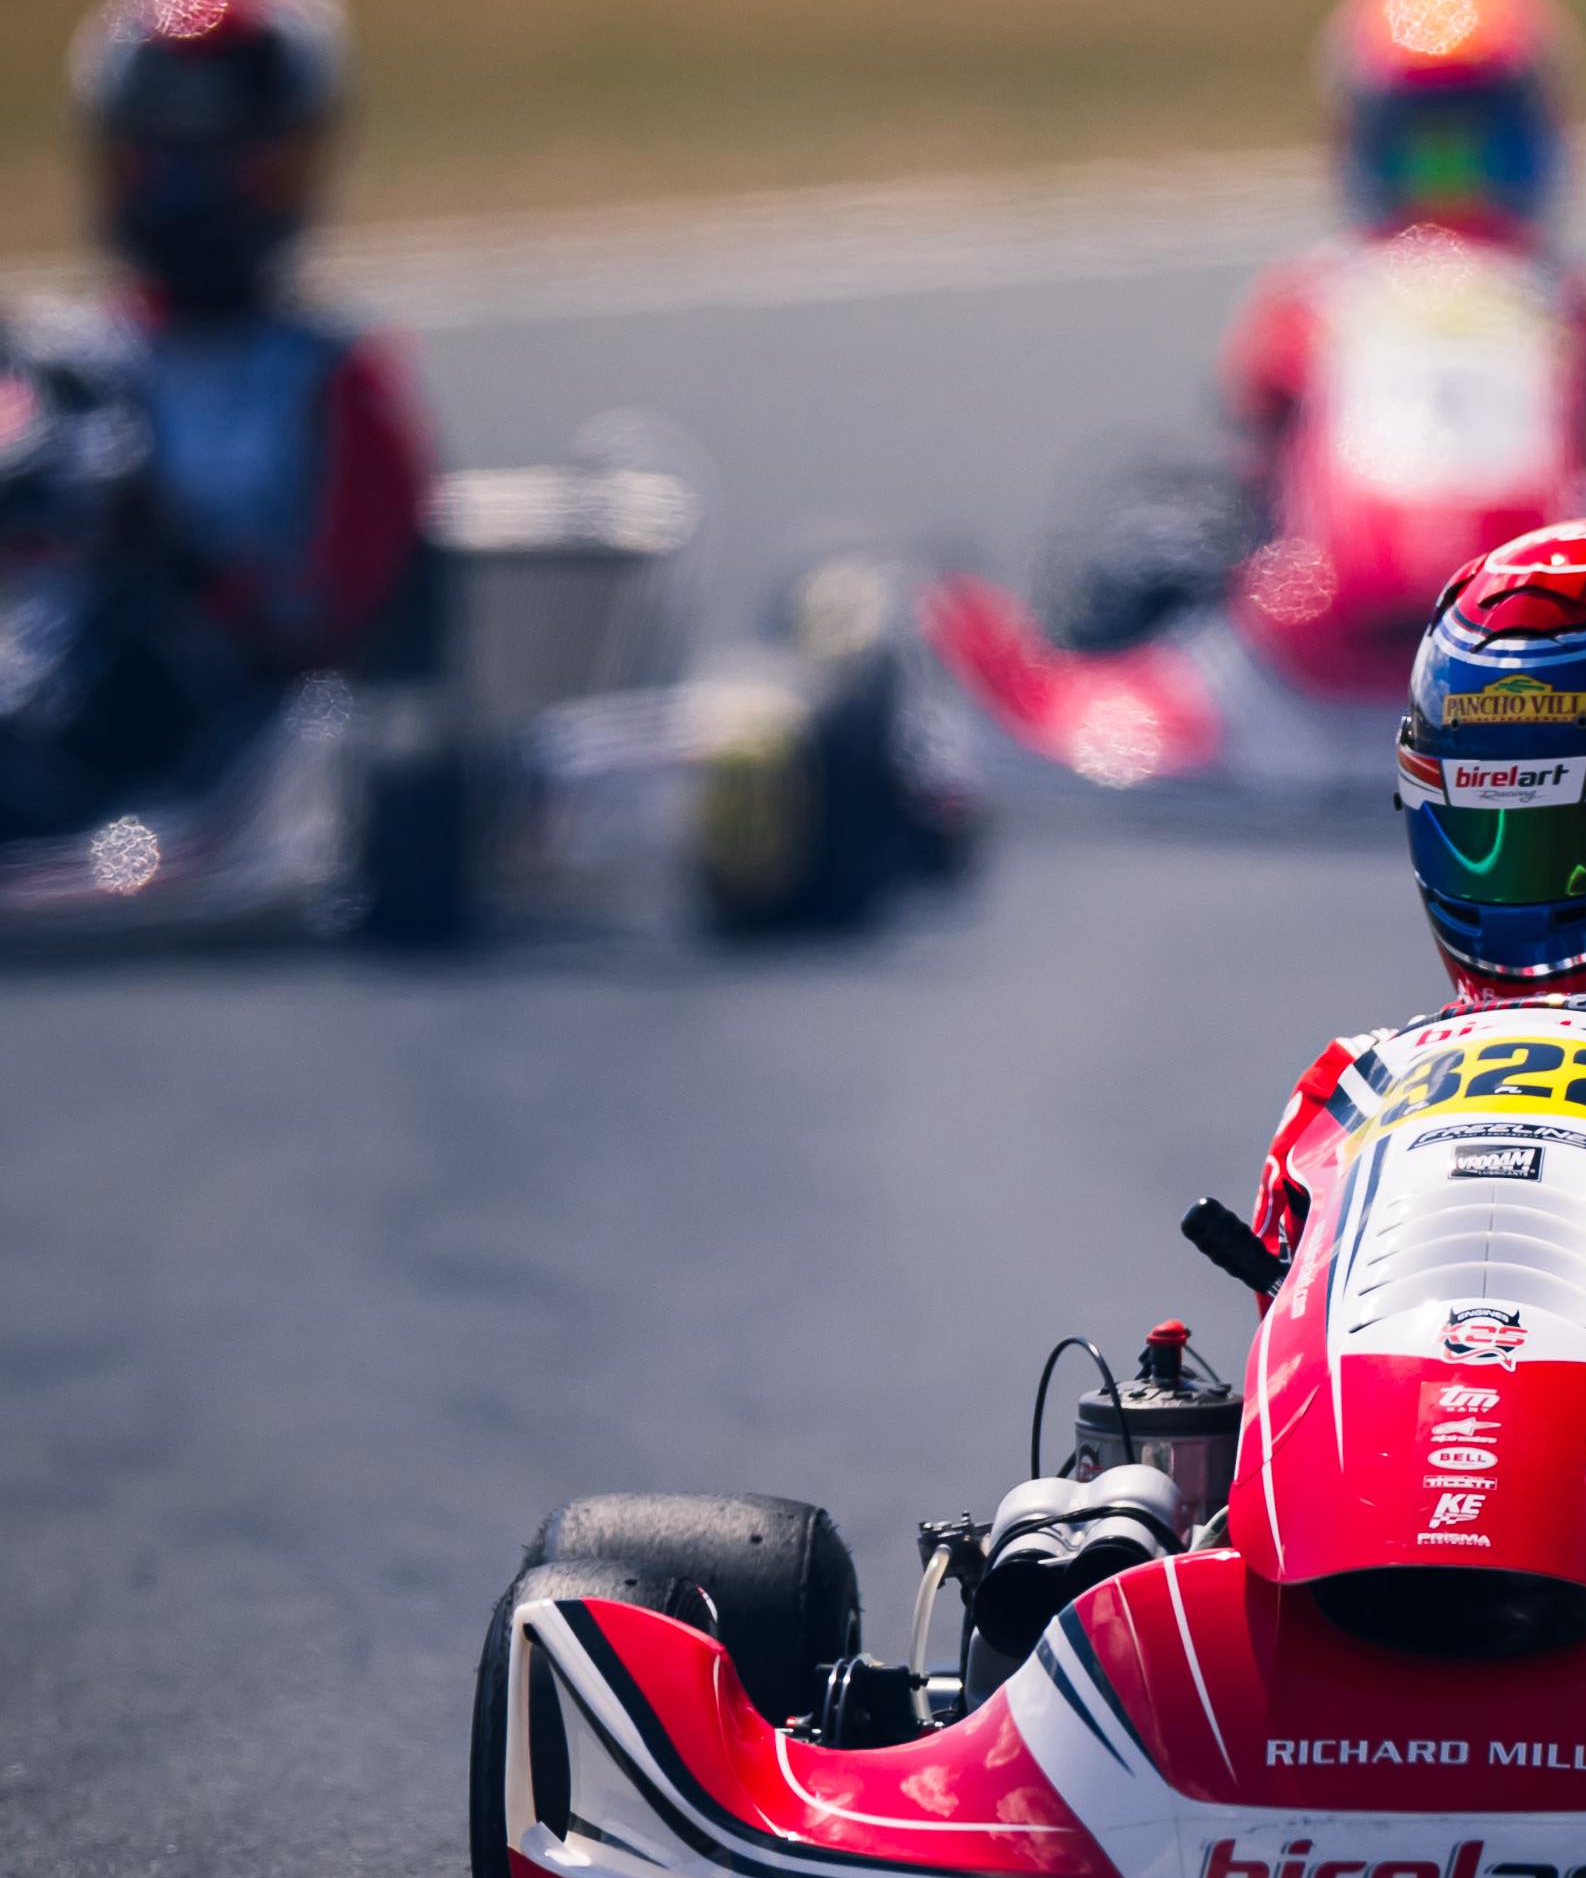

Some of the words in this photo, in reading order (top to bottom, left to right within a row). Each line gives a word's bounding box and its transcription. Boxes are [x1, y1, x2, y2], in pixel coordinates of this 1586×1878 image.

[1446, 695, 1526, 716] PANCHO
[1455, 763, 1570, 789] birelart
[1439, 1452, 1488, 1463] BELL
[1432, 1492, 1487, 1516] KE
[1265, 1739, 1470, 1767] RICHARD
